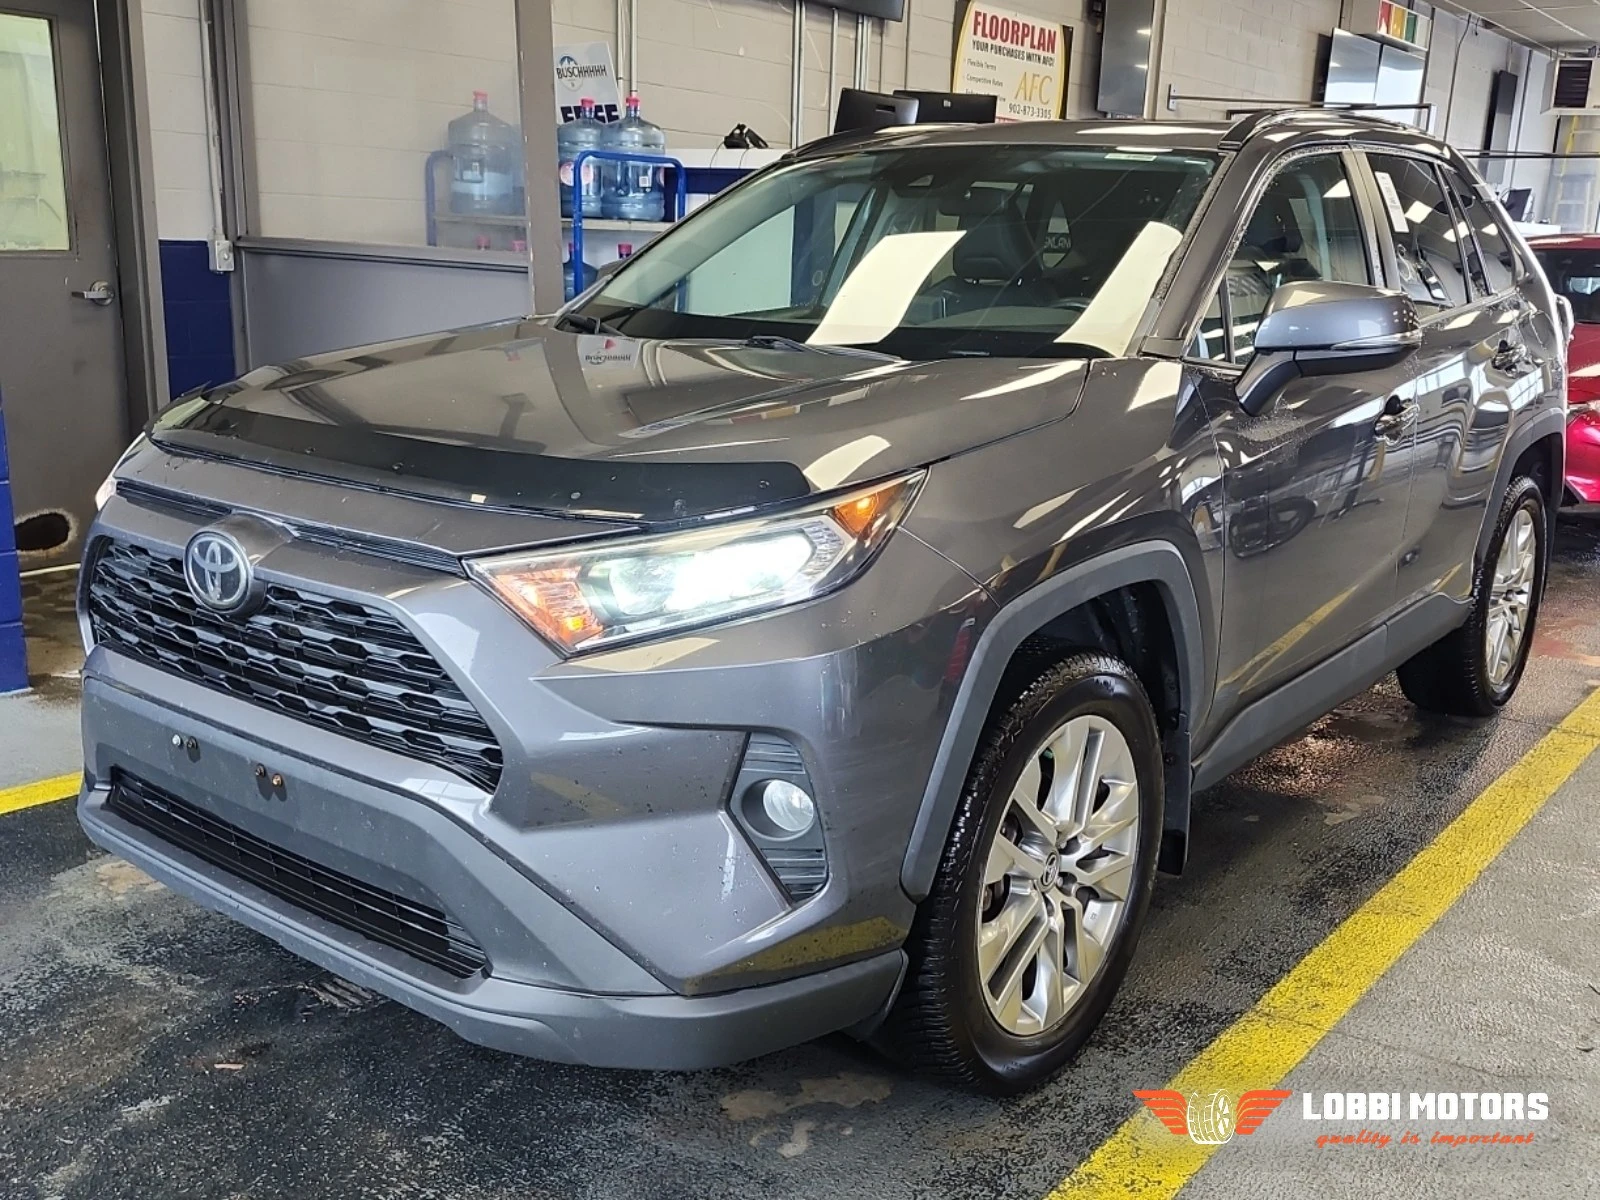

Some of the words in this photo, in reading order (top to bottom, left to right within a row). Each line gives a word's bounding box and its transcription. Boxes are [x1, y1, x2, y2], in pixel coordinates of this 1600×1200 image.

[972, 10, 1057, 54] FLOORPLAN
[972, 39, 989, 53] YOUR
[989, 43, 1025, 61] PURCHASES
[1025, 50, 1041, 65] WITH
[1014, 71, 1052, 105] AFC
